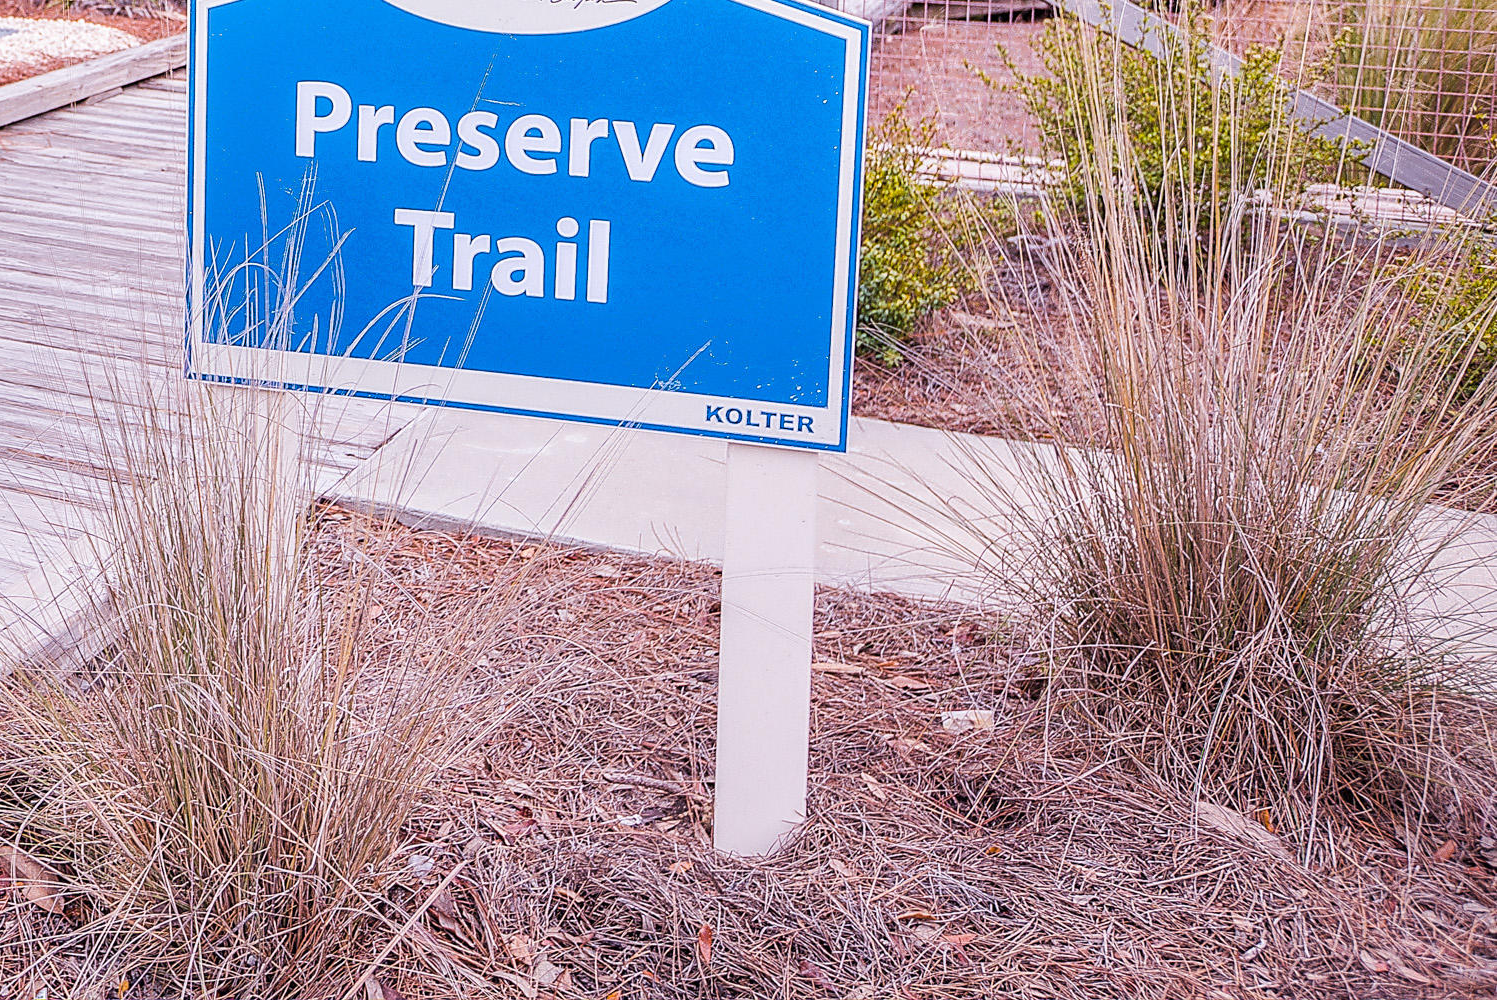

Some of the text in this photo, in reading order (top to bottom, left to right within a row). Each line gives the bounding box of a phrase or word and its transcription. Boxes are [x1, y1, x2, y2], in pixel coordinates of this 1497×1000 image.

[295, 80, 735, 189] Preserve
[394, 207, 611, 305] Trail
[705, 404, 816, 435] KOLTER
